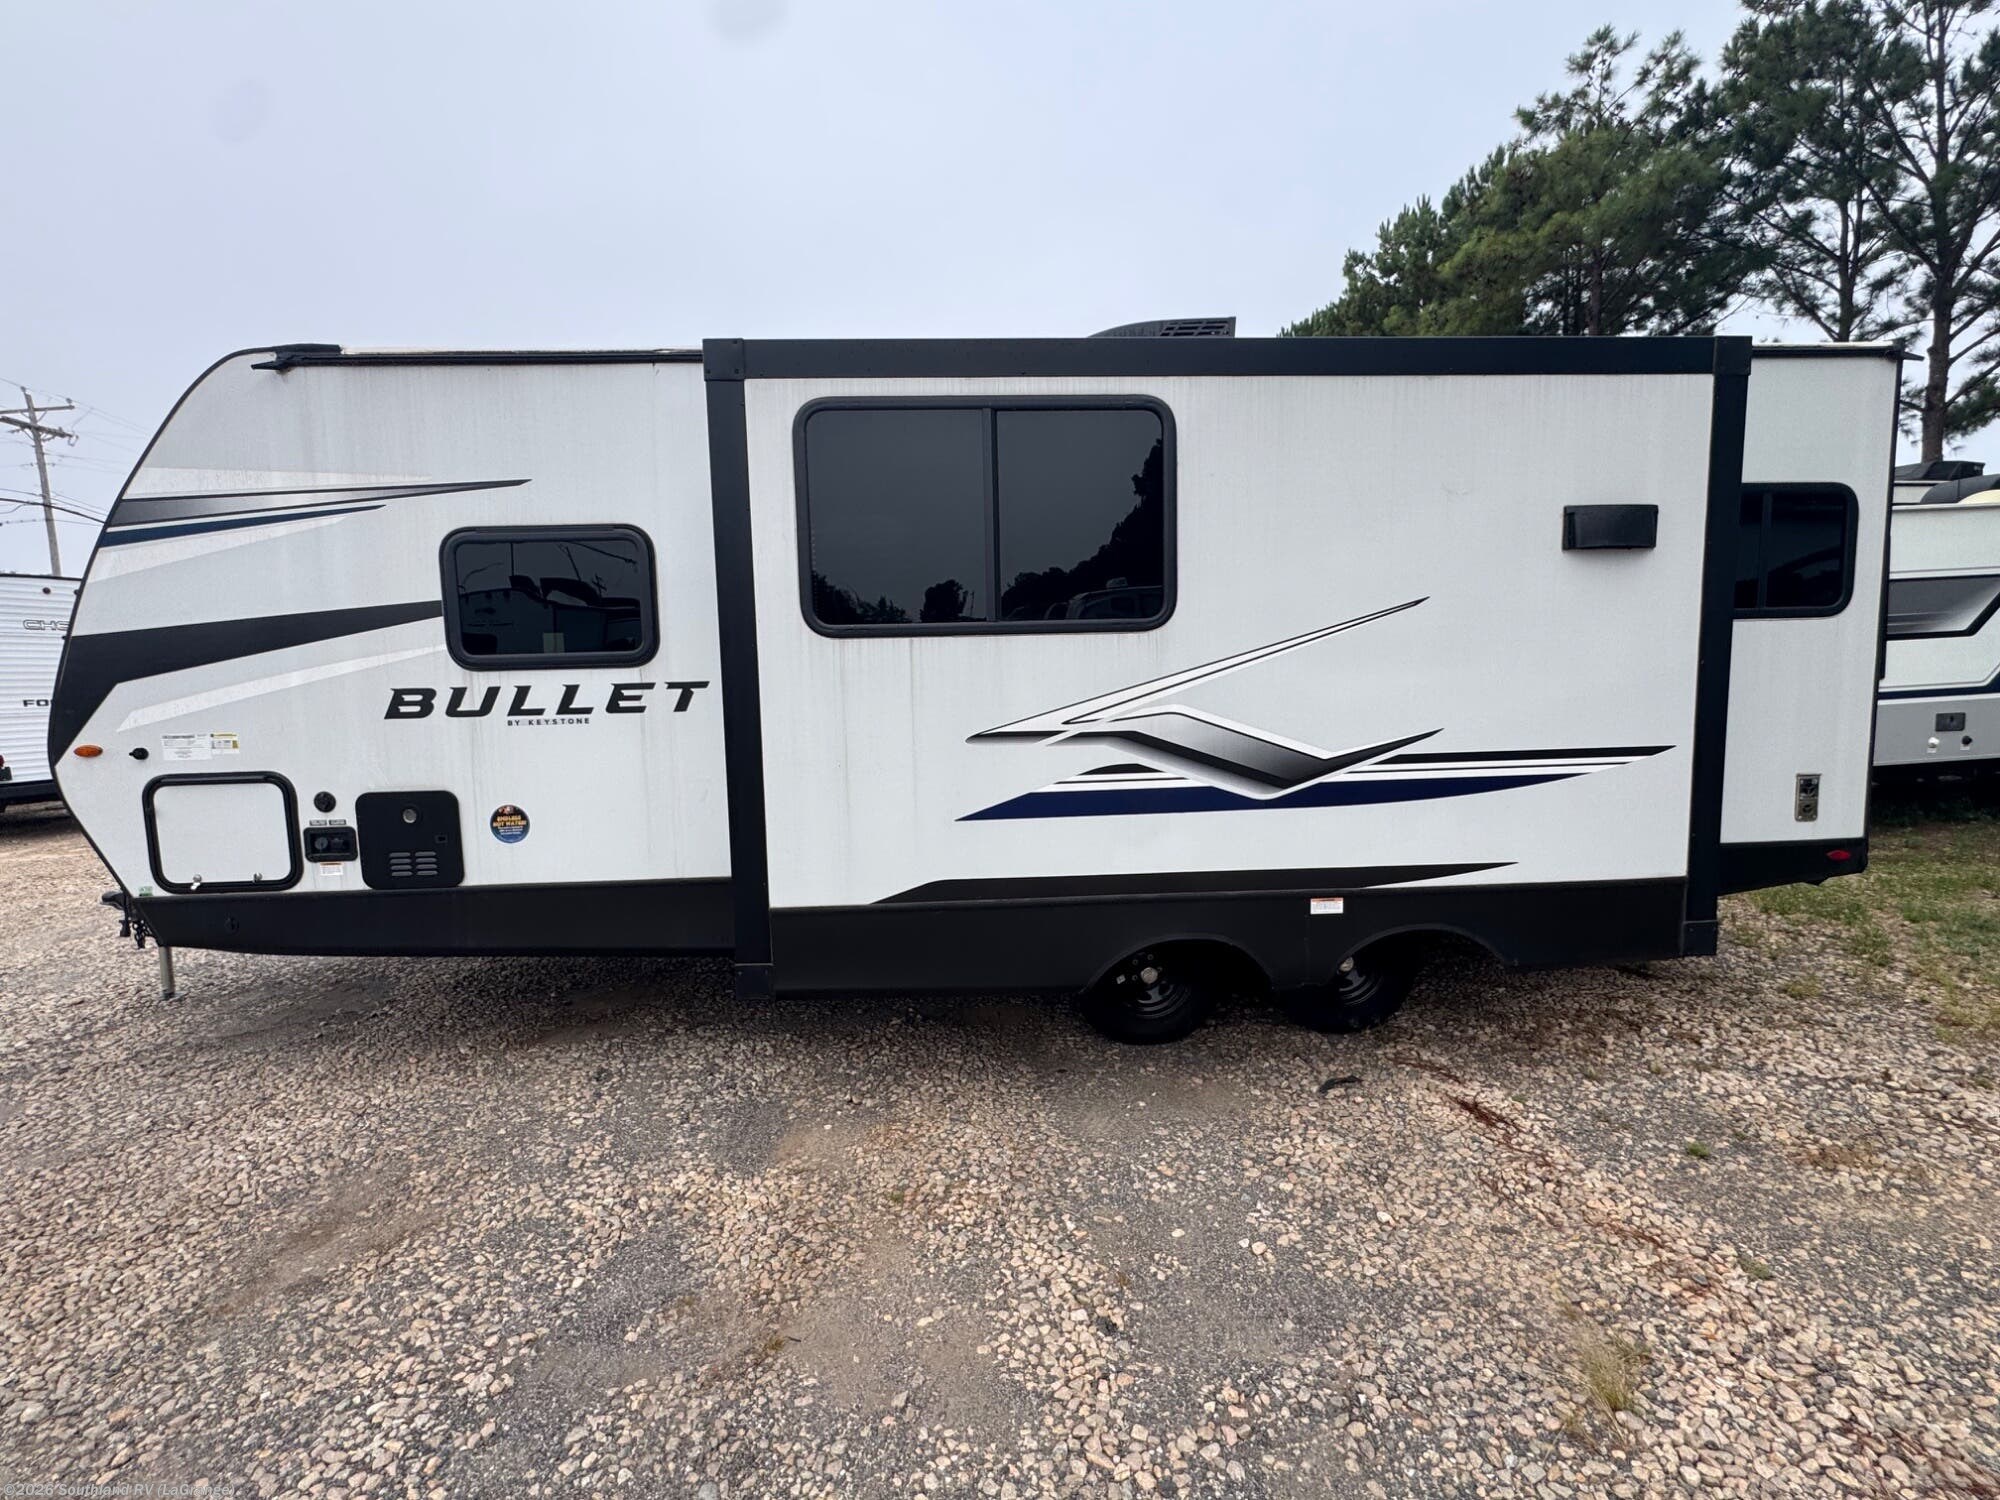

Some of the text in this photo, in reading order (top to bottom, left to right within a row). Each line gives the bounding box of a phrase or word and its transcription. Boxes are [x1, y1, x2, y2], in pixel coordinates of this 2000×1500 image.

[23, 699, 52, 707] FO
[384, 681, 710, 719] BULLET
[507, 717, 591, 727] BY KEYSTONE
